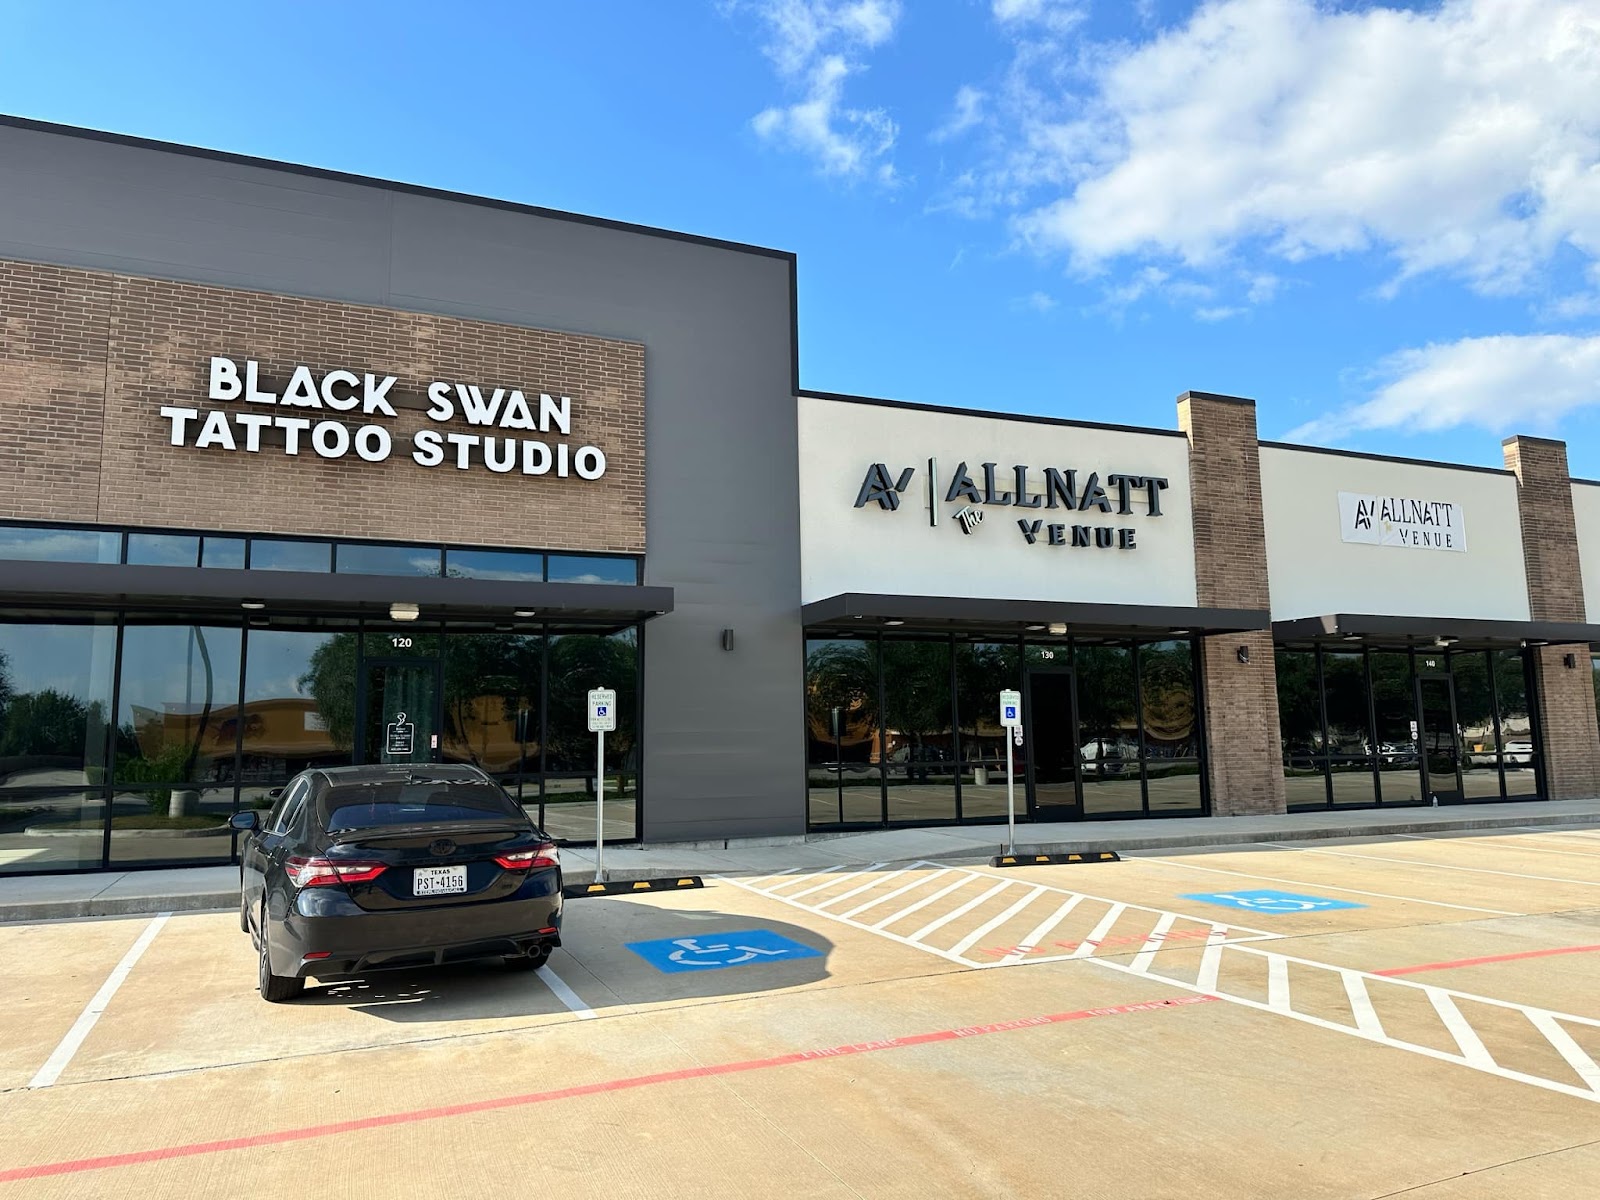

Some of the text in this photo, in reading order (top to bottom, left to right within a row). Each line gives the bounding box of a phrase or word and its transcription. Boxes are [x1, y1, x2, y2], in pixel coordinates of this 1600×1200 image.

[208, 356, 572, 435] BLACK SWAN
[160, 406, 607, 480] TATTOO STUDIO
[945, 461, 1169, 517] ALLNATT
[952, 505, 984, 535] The
[1380, 497, 1453, 527] ALLNATT
[1017, 518, 1137, 550] VENUE
[1399, 528, 1453, 548] VENUE
[392, 637, 412, 648] 120
[1041, 651, 1054, 659] 130
[431, 868, 451, 876] TEXAS
[799, 1047, 846, 1058] FIRE
[851, 1038, 903, 1051] LANE
[951, 1027, 978, 1037] NO
[981, 1017, 1053, 1032] PARKING
